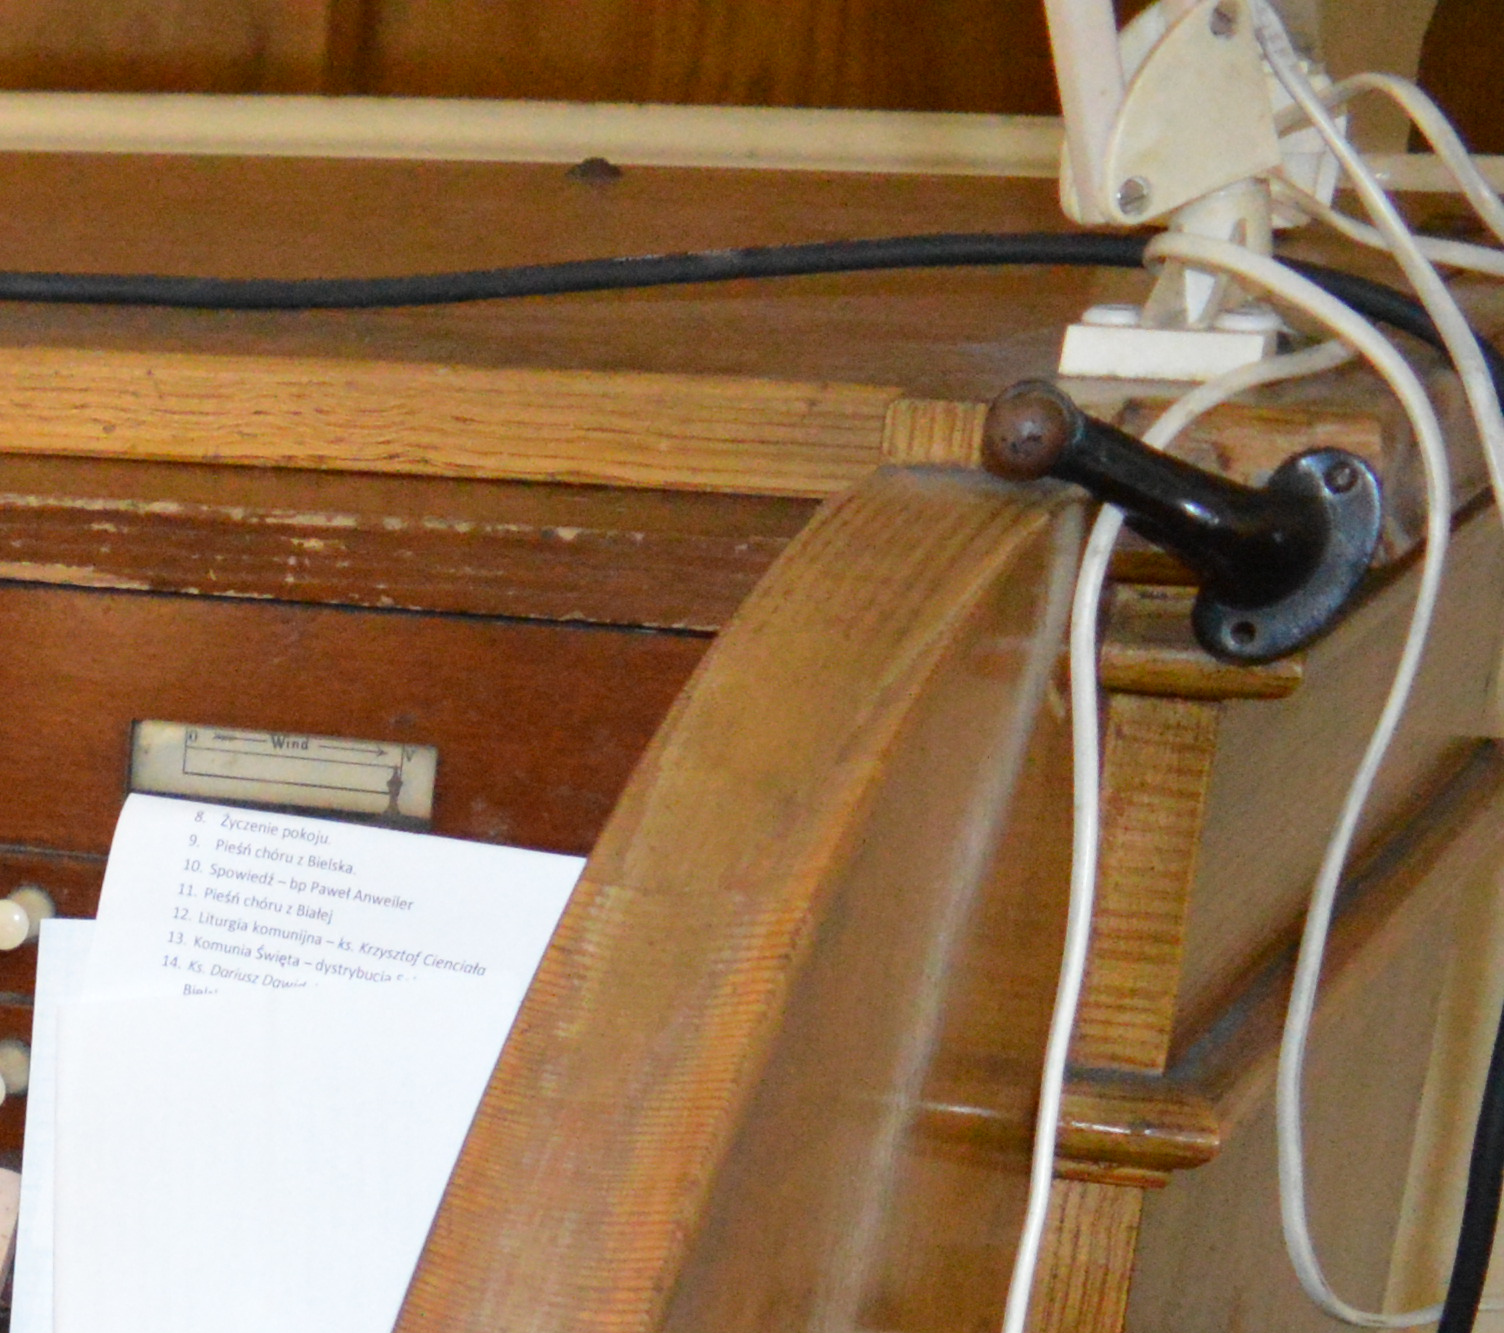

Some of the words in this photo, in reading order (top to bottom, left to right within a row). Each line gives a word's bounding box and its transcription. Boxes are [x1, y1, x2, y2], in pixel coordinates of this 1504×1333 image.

[270, 733, 309, 750] Wind
[195, 811, 206, 824] 8.
[219, 813, 278, 836] Życzenie
[189, 834, 200, 848] 9.
[216, 838, 251, 857] Pieśń
[255, 845, 294, 864] chóru
[297, 855, 304, 865] z
[183, 858, 203, 873] 10.
[209, 863, 275, 886] Spowiedź
[290, 877, 307, 893] bp
[310, 882, 350, 900] Paweł
[353, 889, 415, 911] Anweiler
[178, 883, 197, 897] 11.
[204, 887, 240, 905] Pieśń
[243, 894, 283, 914] chóru
[286, 904, 293, 915] z
[296, 904, 334, 925] Białej
[168, 931, 186, 945] 13.
[193, 936, 252, 959] Komunia
[256, 943, 301, 968] Święta
[173, 907, 192, 921] 12.
[198, 911, 248, 932] Liturgia
[252, 921, 322, 946] komunijna
[337, 938, 355, 952] ks.
[359, 941, 422, 966] Krzysztof
[423, 953, 486, 977] Cienciała
[162, 955, 181, 970] 14.
[188, 960, 206, 975] Ks.
[210, 964, 260, 985] Dariusz
